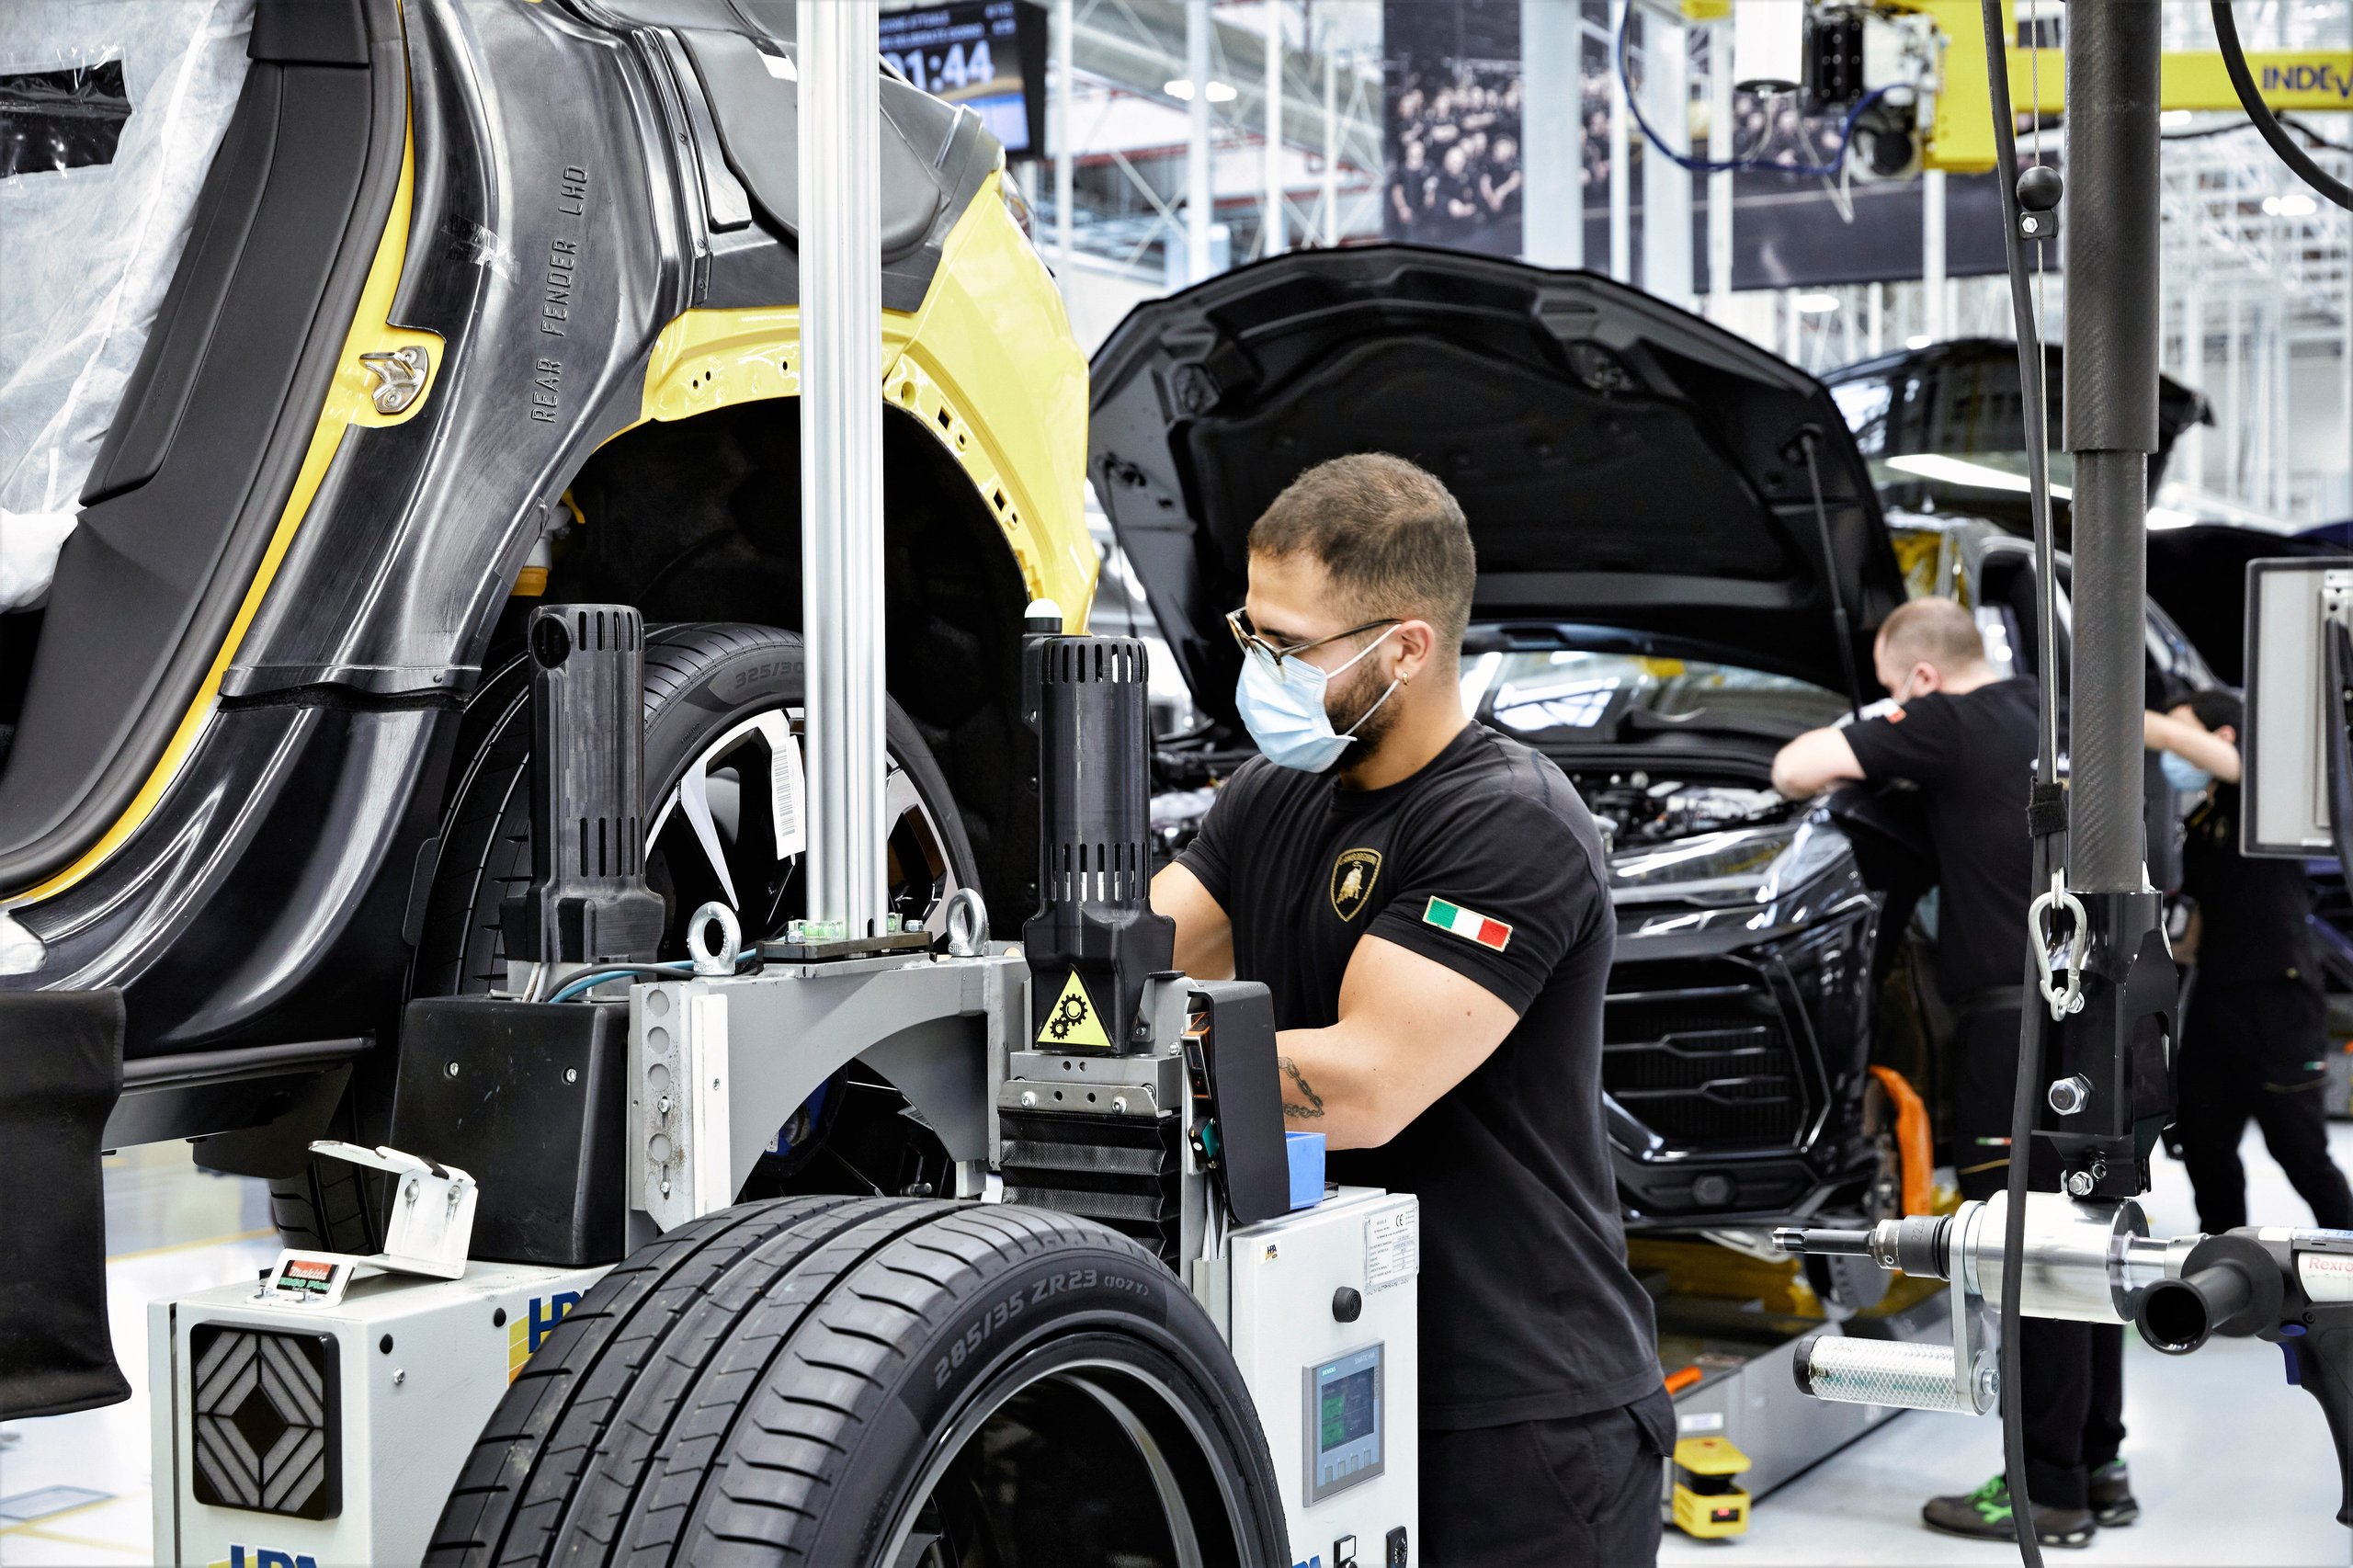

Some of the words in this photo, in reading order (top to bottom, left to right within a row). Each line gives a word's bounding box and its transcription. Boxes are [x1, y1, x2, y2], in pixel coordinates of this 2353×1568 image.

[558, 165, 589, 216] LHD
[540, 238, 577, 337] FENDER
[531, 358, 562, 424] REAR
[529, 1290, 593, 1354] HP
[934, 1290, 1025, 1391] 285/35
[1031, 1268, 1098, 1305] ZR23
[1104, 1275, 1150, 1297] (107Y)
[1322, 1366, 1336, 1376] SIEMENS
